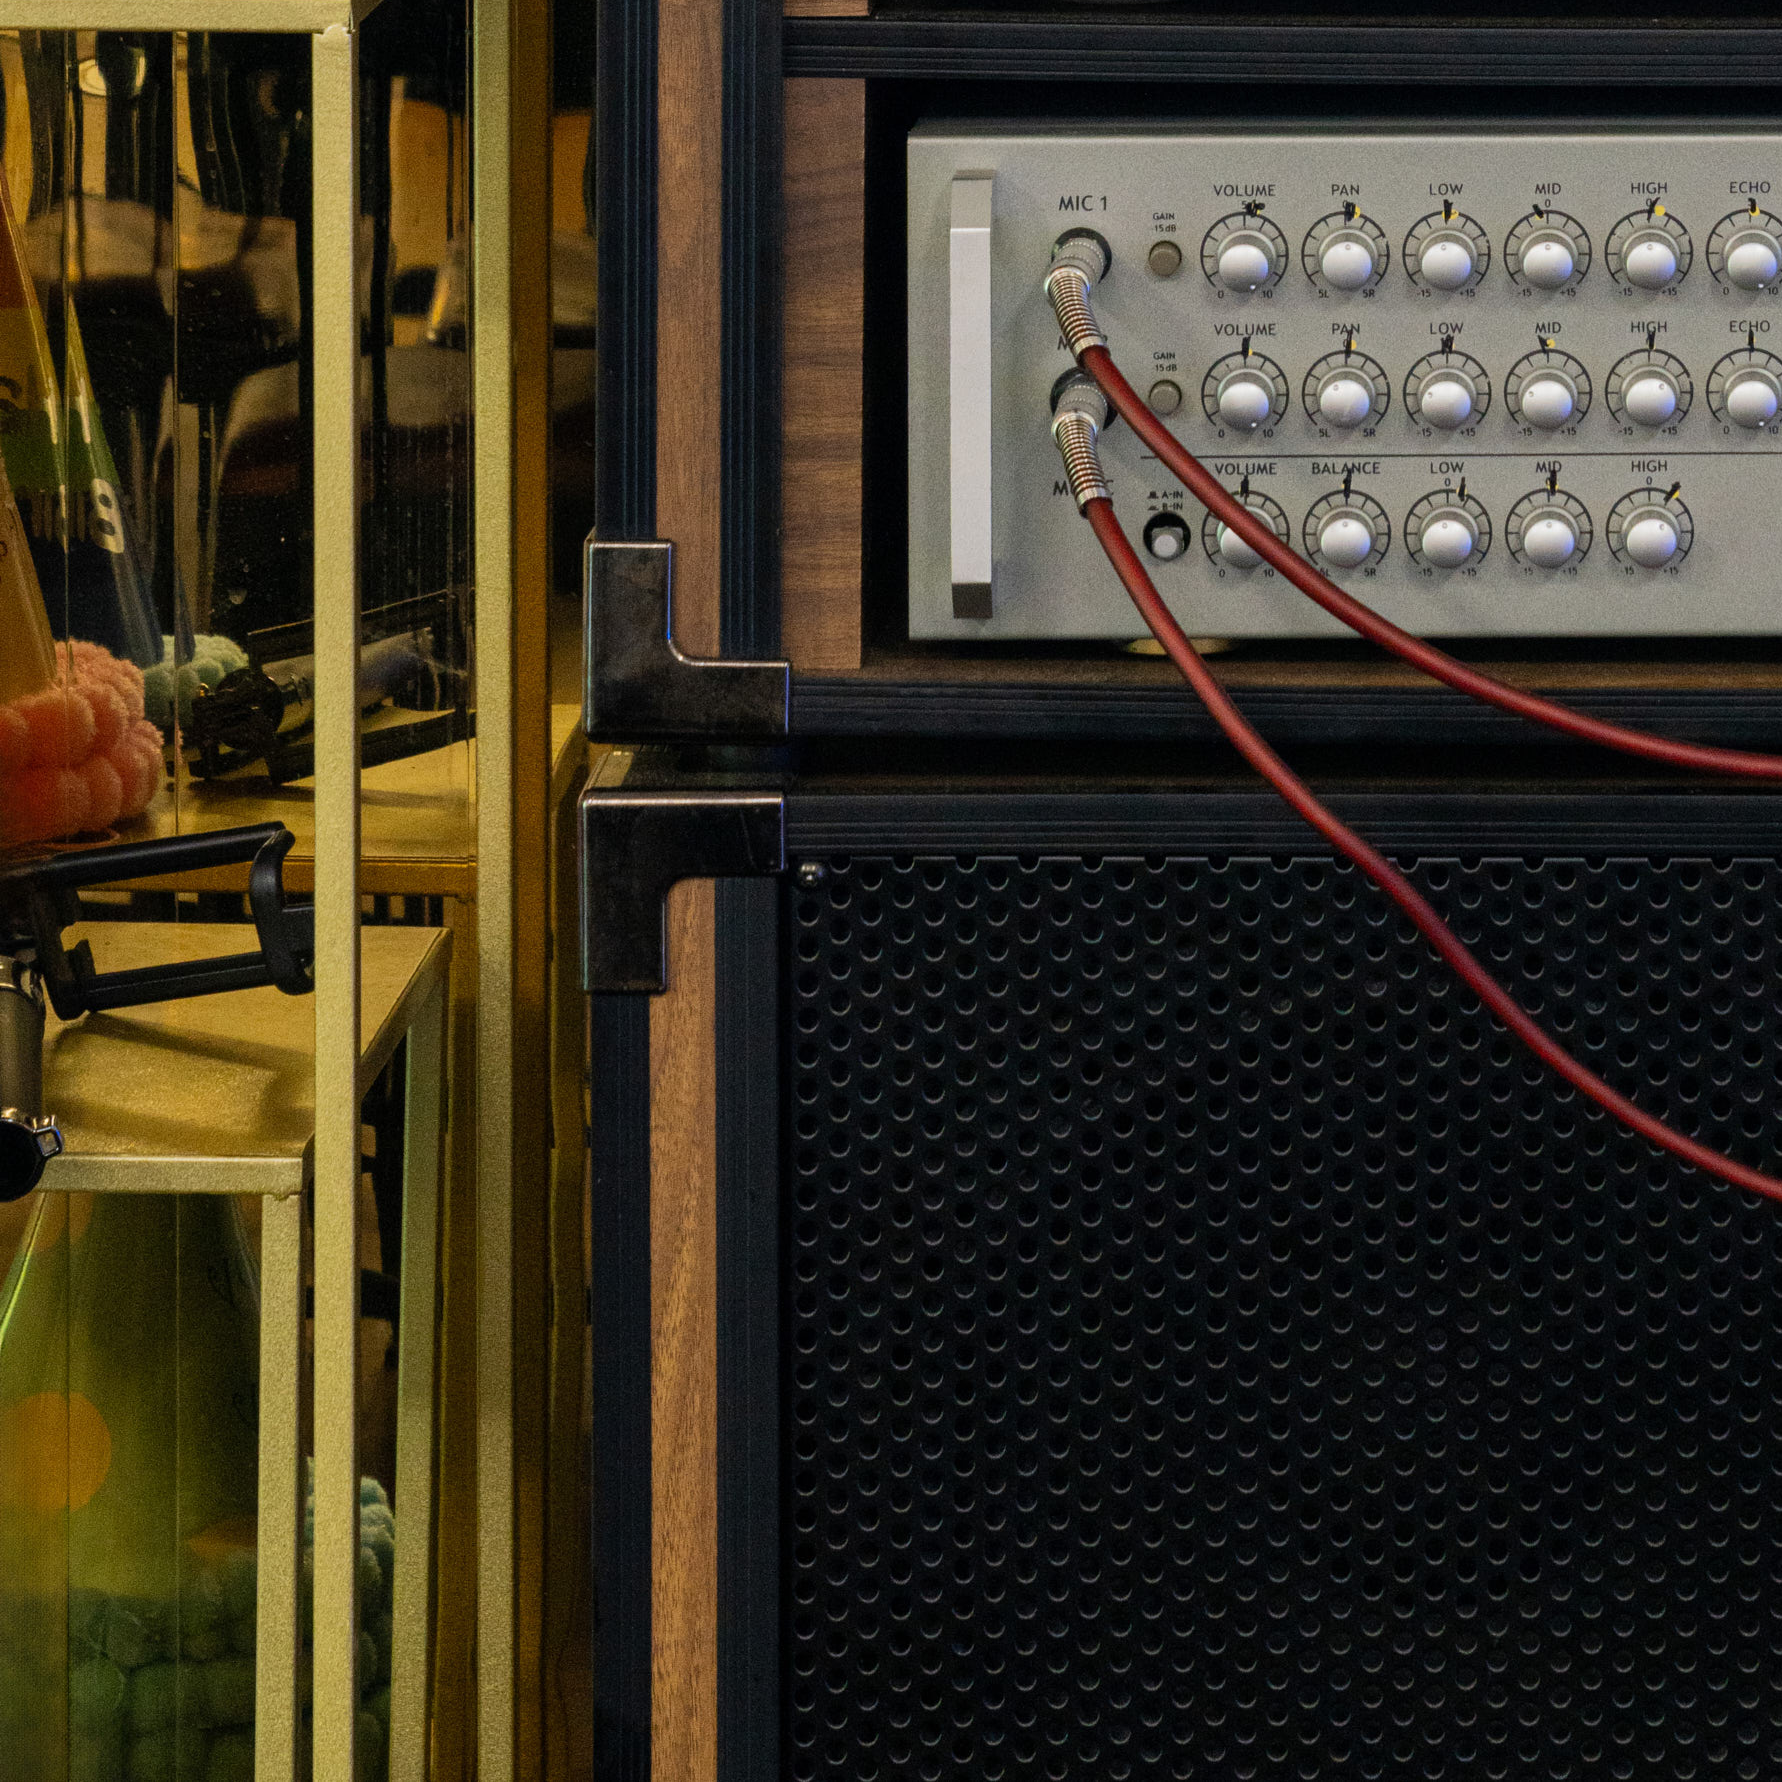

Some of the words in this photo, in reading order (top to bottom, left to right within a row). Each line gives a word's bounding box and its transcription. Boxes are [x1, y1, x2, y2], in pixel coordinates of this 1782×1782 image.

[1213, 184, 1276, 197] VOLUME
[1331, 184, 1360, 196] PAN
[1429, 183, 1463, 196] LOW
[1535, 183, 1562, 195] MID
[1631, 182, 1668, 194] HIGH
[1729, 181, 1771, 194] ECHO
[1058, 195, 1093, 212] MIC
[1100, 195, 1107, 211] 1
[1545, 199, 1551, 208] 0
[1152, 212, 1175, 221] GAIN
[1217, 290, 1225, 299] 0
[1262, 289, 1273, 299] 10
[1723, 287, 1729, 296] 0
[1767, 286, 1778, 296] 10
[1214, 323, 1276, 336] VOLUME
[1332, 323, 1360, 335] PAN
[1429, 322, 1463, 334] LOW
[1535, 321, 1562, 334] MID
[1631, 321, 1668, 333] HIGH
[1729, 320, 1770, 333] ECHO
[1153, 351, 1176, 360] GAIN
[1218, 429, 1225, 439] 0
[1262, 428, 1273, 439] 10
[1723, 426, 1730, 435] 0
[1768, 426, 1779, 435] 10
[1215, 462, 1277, 475] VOLUME
[1311, 461, 1380, 475] BALANCE
[1430, 461, 1465, 474] LOW
[1536, 461, 1562, 473] MID
[1631, 460, 1668, 472] HIGH
[1445, 478, 1451, 486] 0
[1646, 476, 1653, 485] 0
[1219, 568, 1226, 578] 0
[1263, 568, 1274, 578] 10
